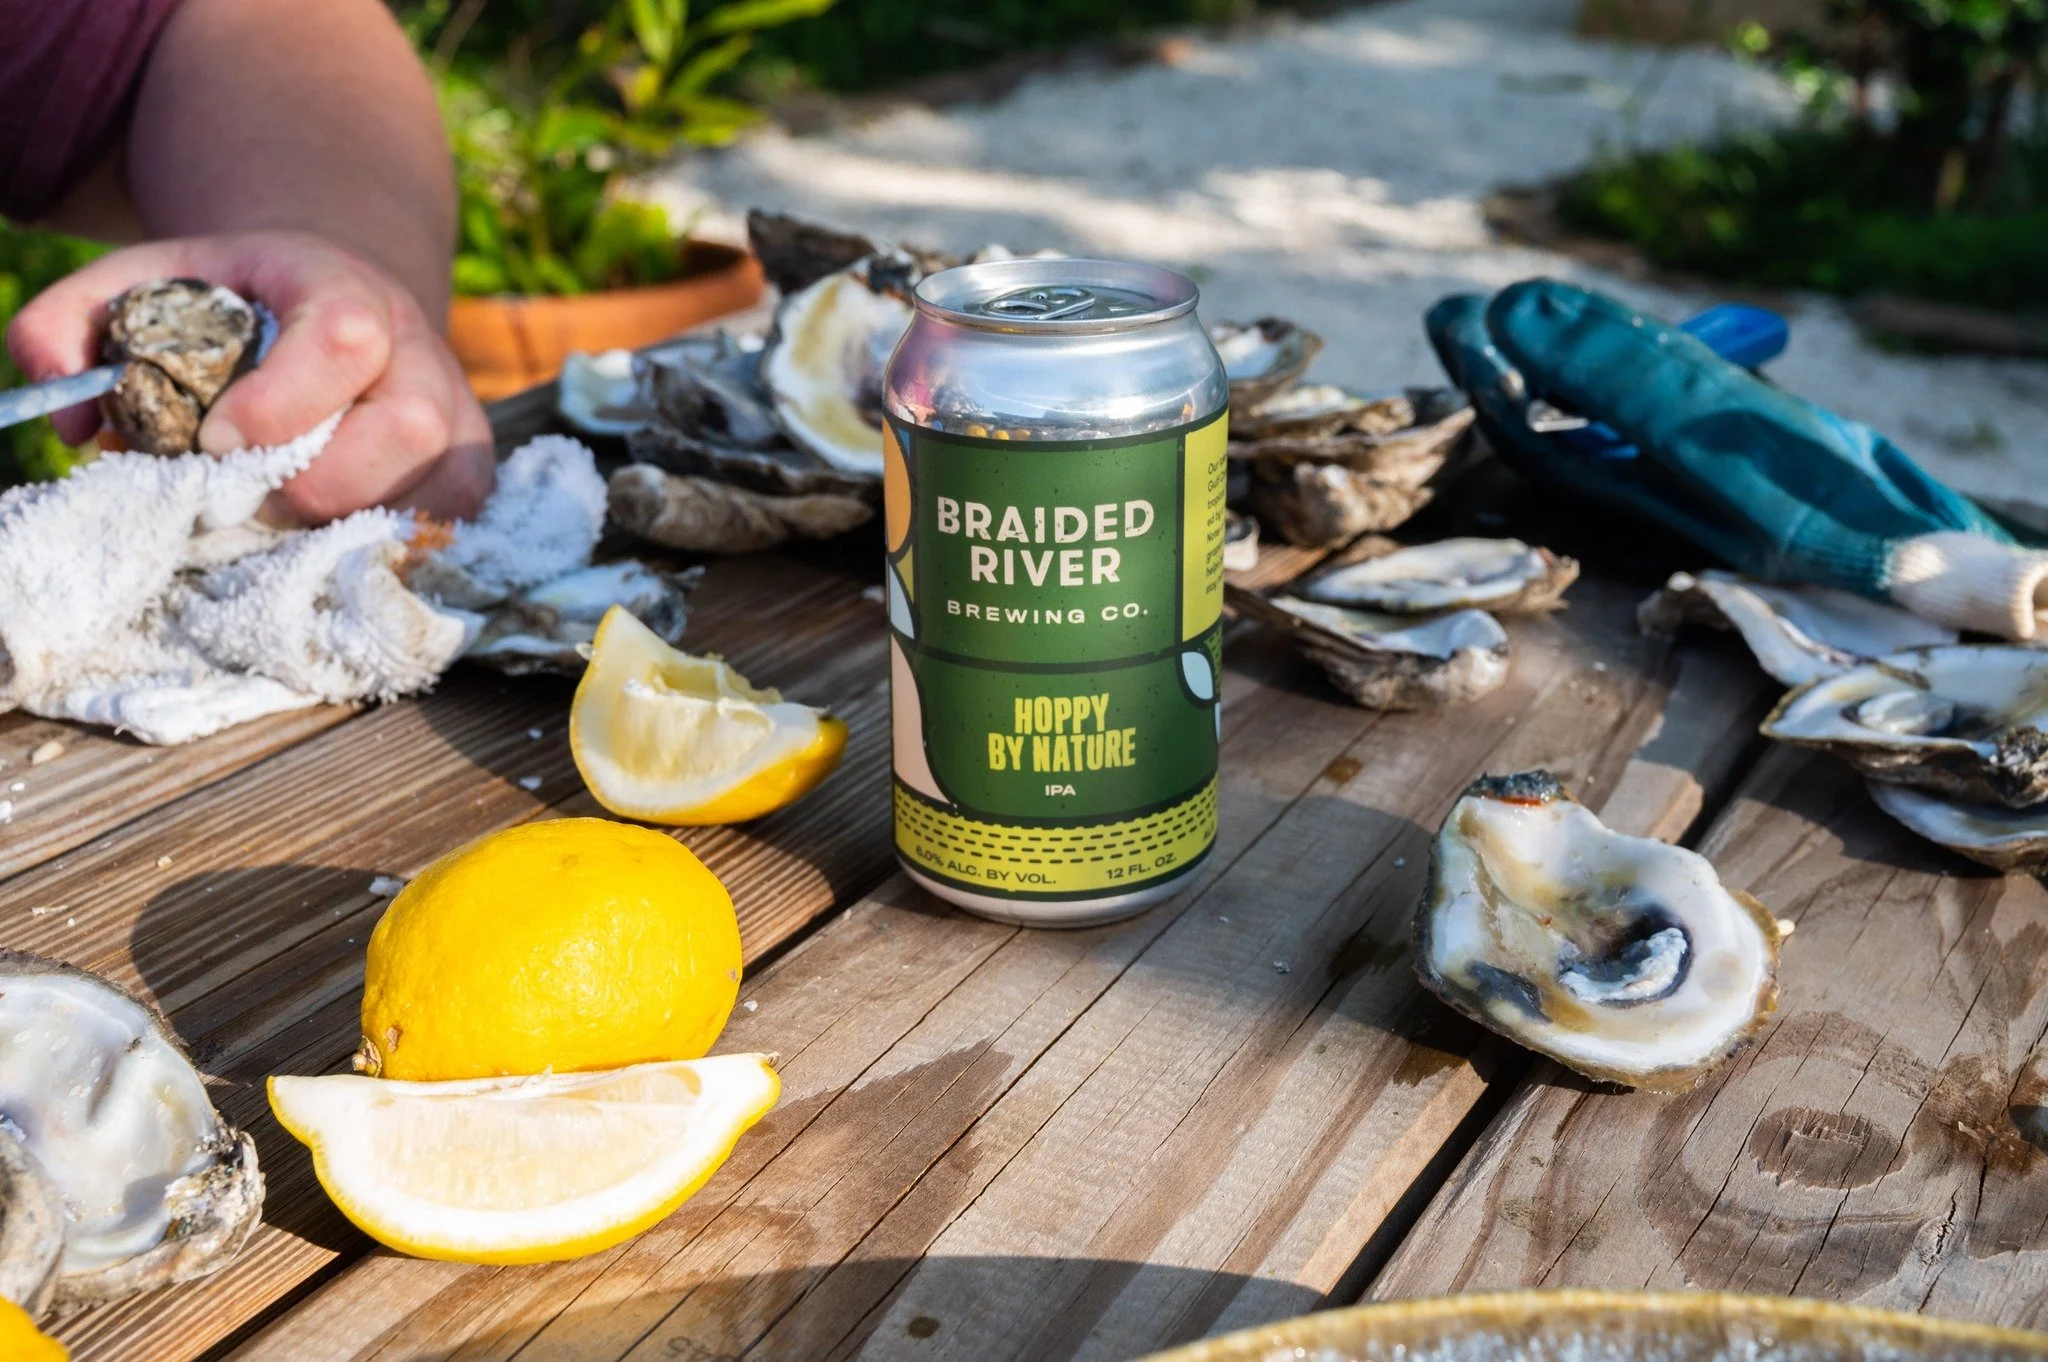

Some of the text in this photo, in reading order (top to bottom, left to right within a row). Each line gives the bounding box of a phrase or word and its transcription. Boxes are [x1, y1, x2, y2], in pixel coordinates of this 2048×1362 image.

[937, 496, 1154, 543] BRAIDED
[971, 546, 1120, 586] RIVER
[947, 600, 1148, 624] BREWING CO.
[1015, 693, 1109, 734] HOPPY
[988, 727, 1136, 772] BY NATURE
[1045, 784, 1076, 796] IPA
[947, 860, 981, 877] ALC.
[986, 869, 1010, 881] BY
[1015, 872, 1057, 884] VOL.
[1106, 852, 1177, 879] 12 FL. OZ.
